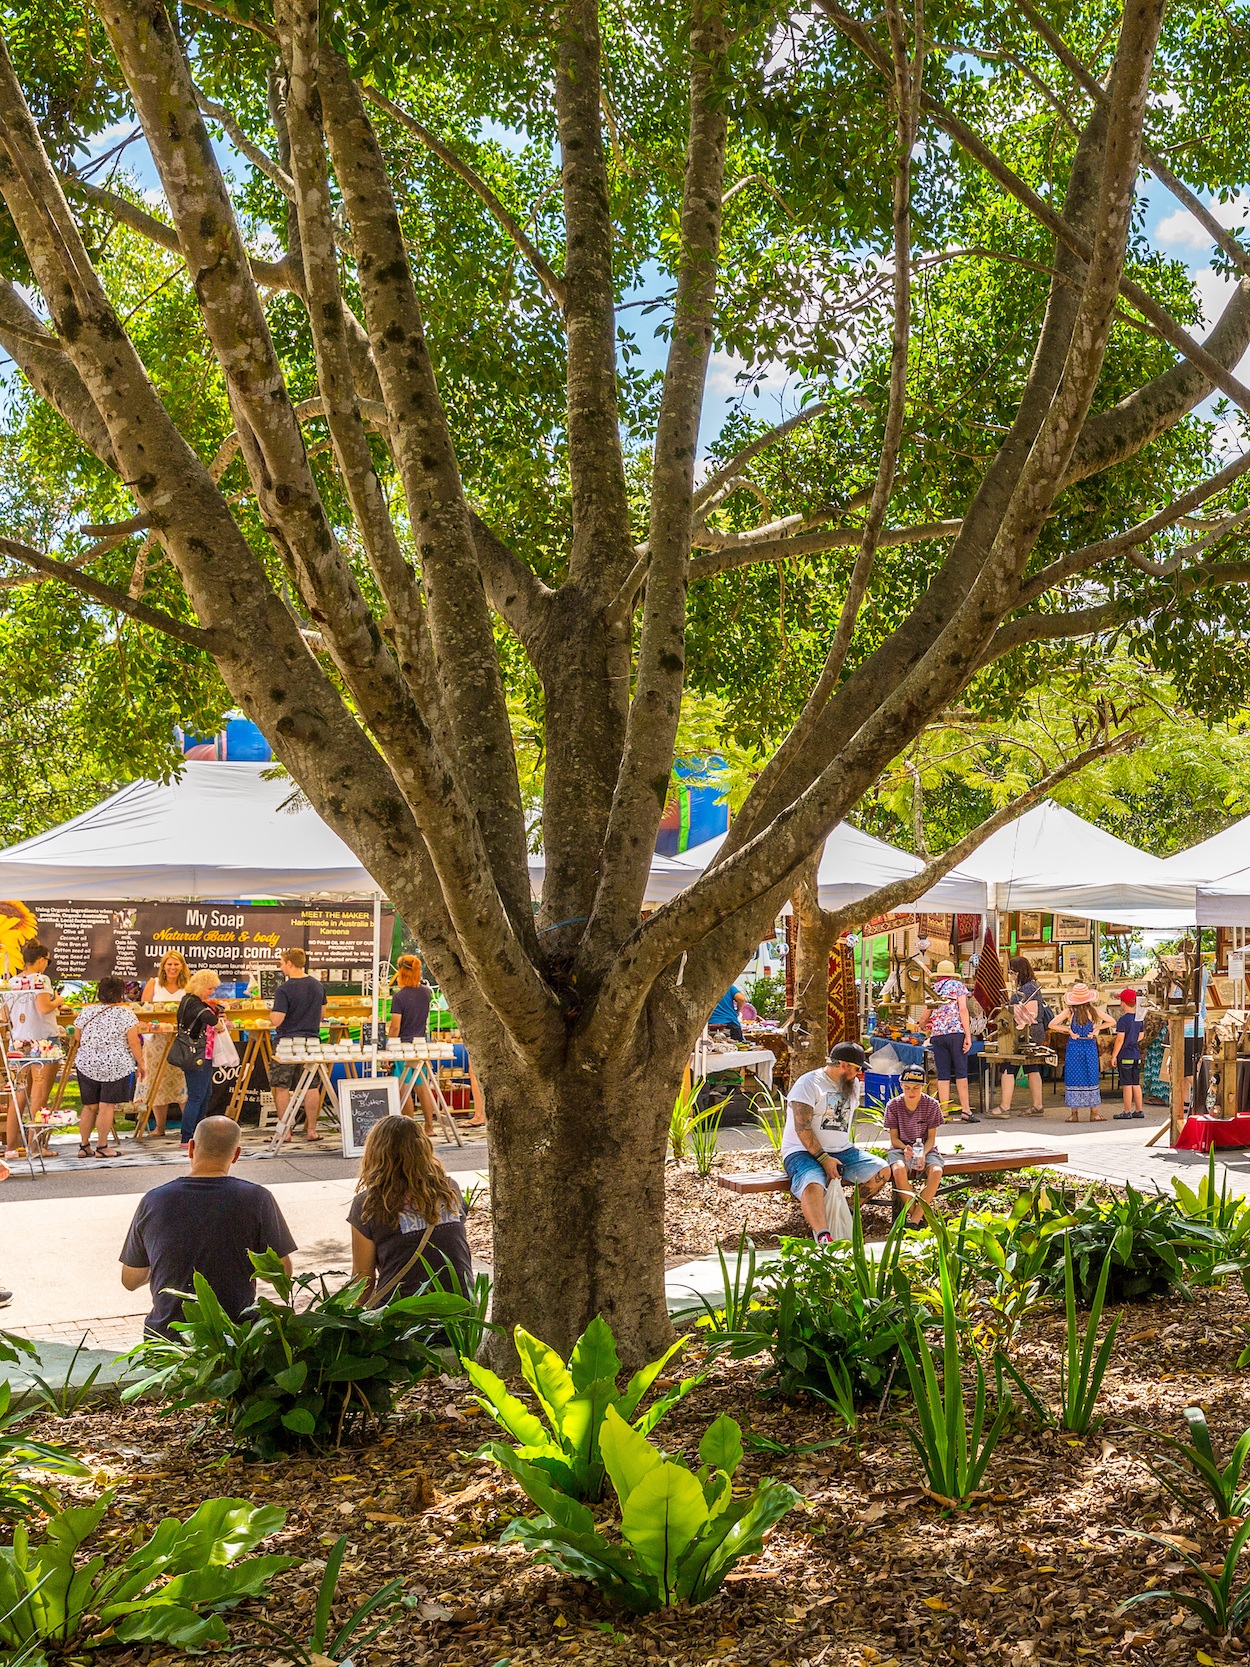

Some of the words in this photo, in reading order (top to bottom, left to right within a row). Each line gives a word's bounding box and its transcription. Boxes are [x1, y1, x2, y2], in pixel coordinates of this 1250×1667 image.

[186, 909, 208, 928] My
[211, 910, 244, 929] Soap
[152, 927, 203, 942] Natural
[203, 930, 236, 942] Bath
[238, 930, 250, 942] &
[253, 932, 280, 947] body
